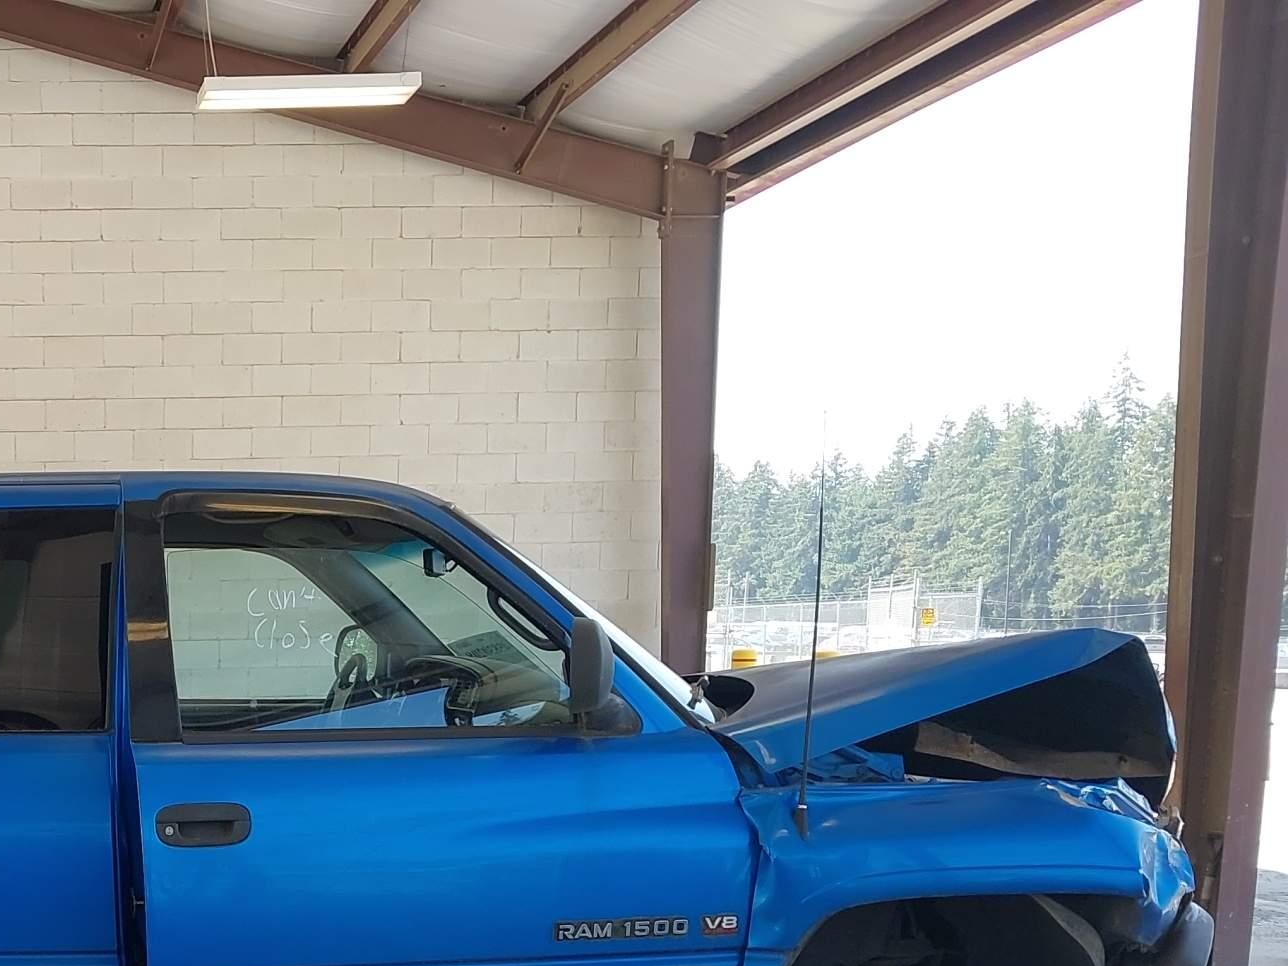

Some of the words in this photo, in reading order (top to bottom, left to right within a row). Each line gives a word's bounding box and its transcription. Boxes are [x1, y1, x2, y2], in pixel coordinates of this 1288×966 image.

[558, 922, 612, 940] RAM
[624, 918, 689, 937] 1500
[704, 915, 738, 930] V8
